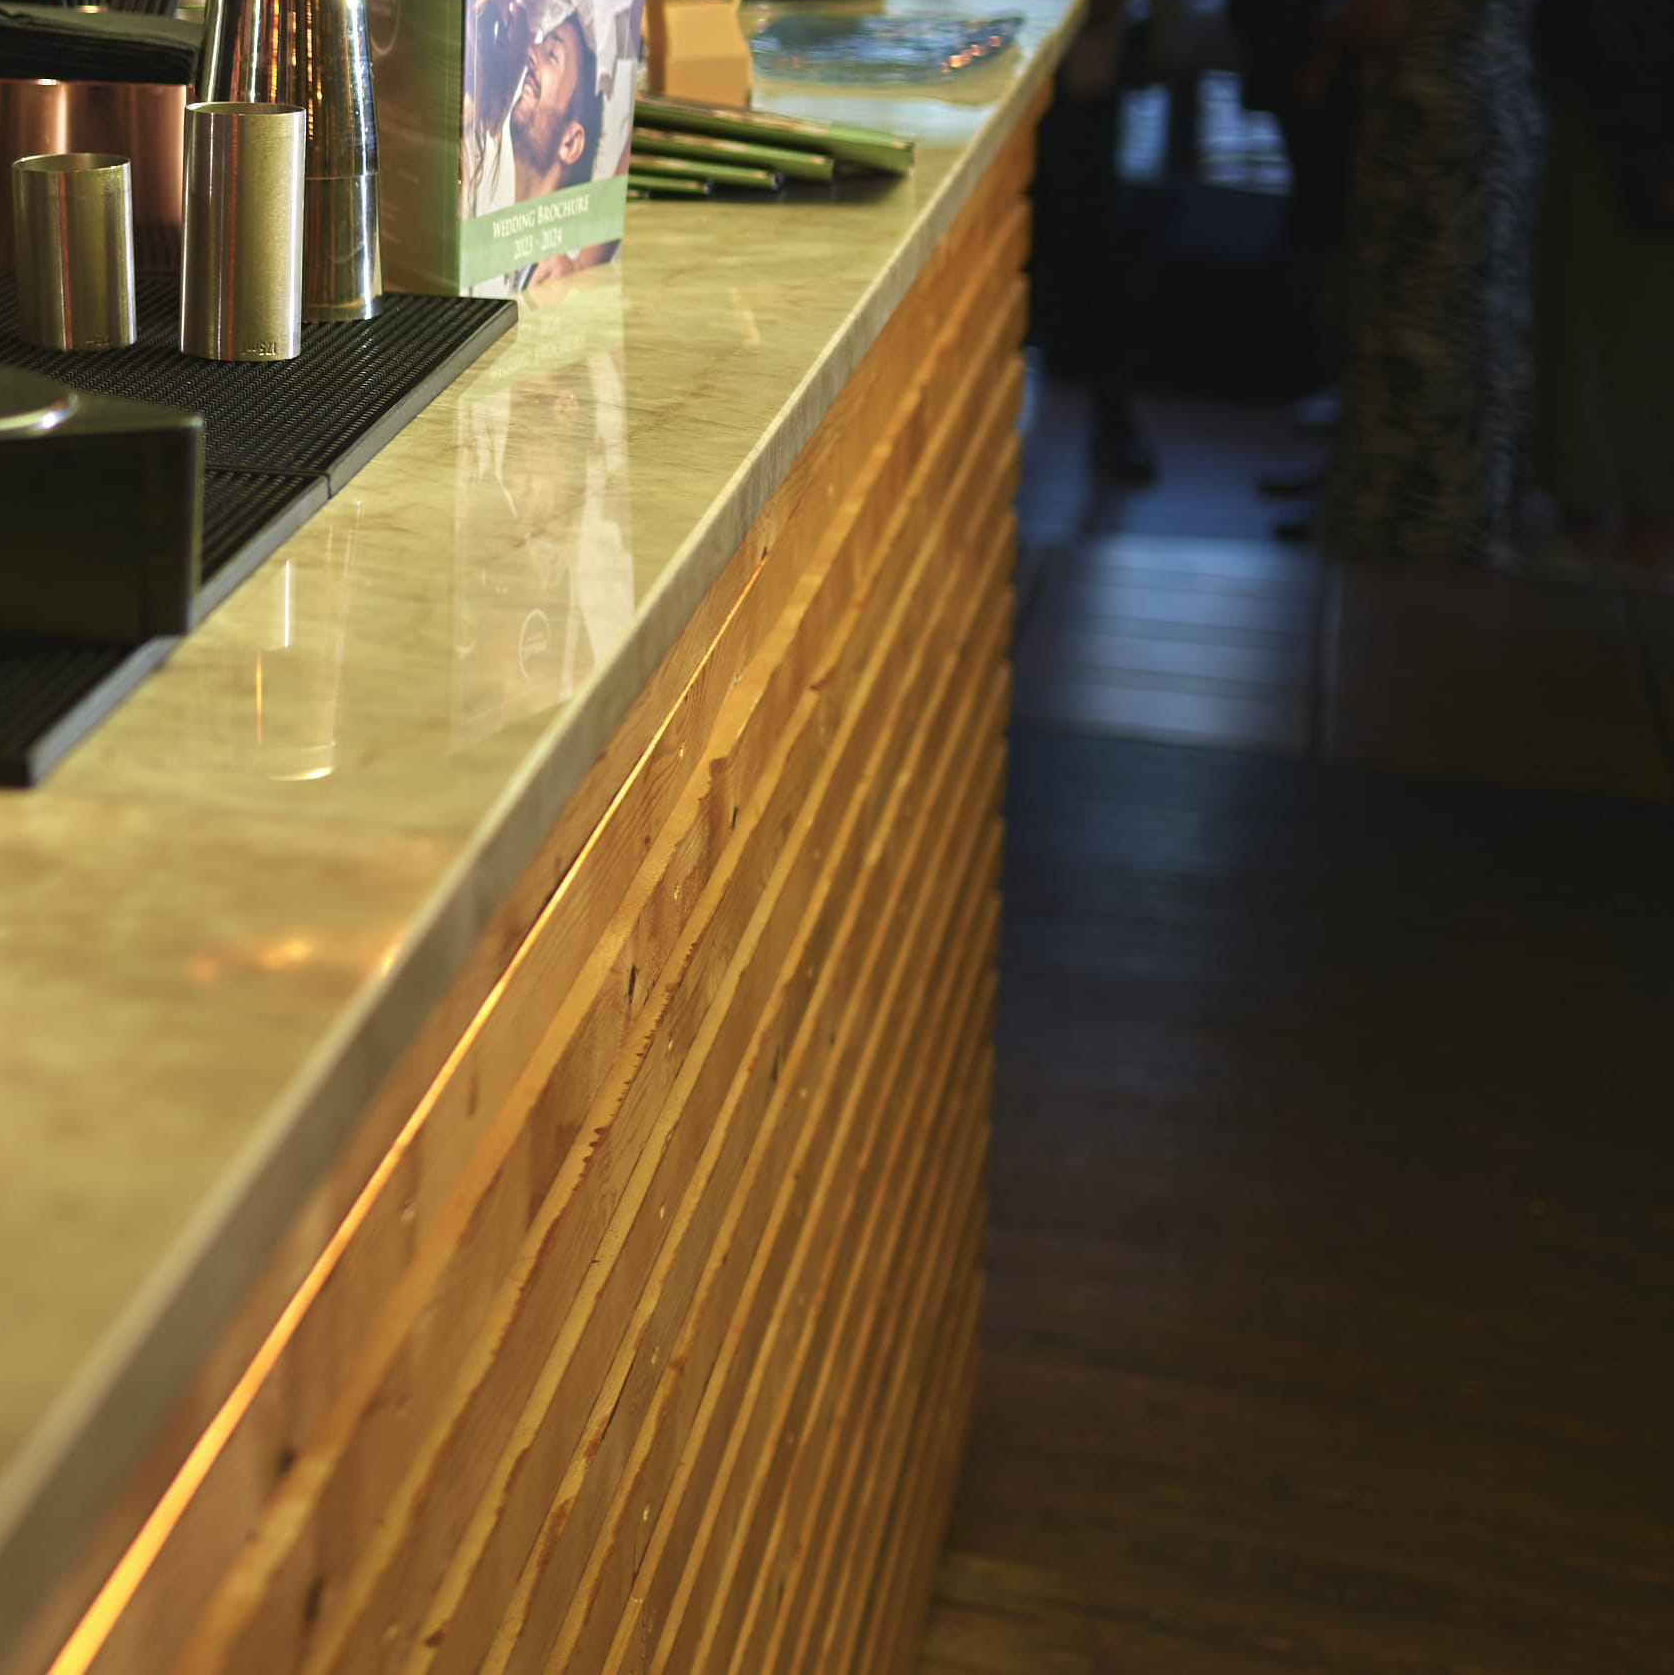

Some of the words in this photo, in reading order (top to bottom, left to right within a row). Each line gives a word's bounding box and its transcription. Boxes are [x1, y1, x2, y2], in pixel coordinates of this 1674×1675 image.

[493, 210, 535, 238] WEDDING
[537, 194, 589, 225] BROCHURE
[514, 235, 533, 260] 2023
[541, 226, 562, 251] 2024
